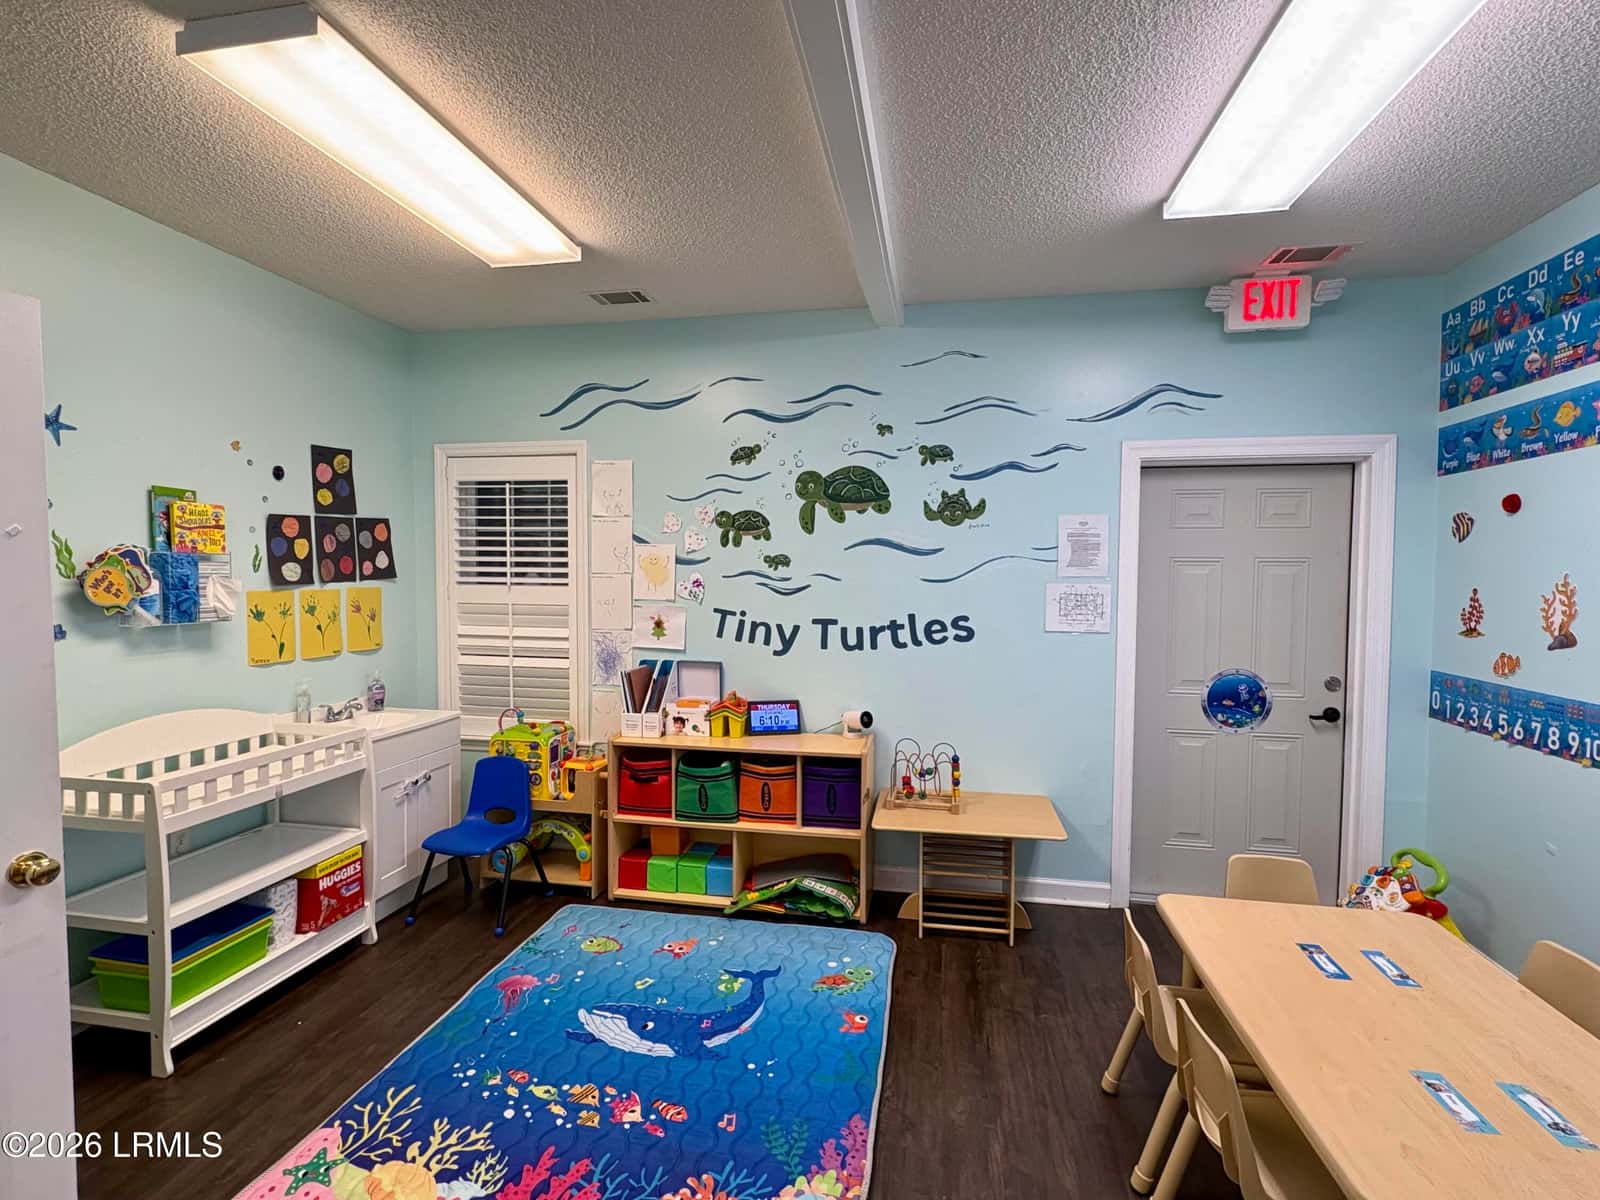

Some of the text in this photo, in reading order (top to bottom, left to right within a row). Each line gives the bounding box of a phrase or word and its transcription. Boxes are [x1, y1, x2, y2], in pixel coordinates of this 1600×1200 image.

[1243, 280, 1301, 322] EXIT
[1446, 250, 1585, 328] Aa Bb Cc Dd Ee
[1445, 361, 1460, 377] Uu
[1470, 351, 1485, 368] Vv
[1494, 339, 1515, 356] Ww
[1527, 326, 1545, 346] Xx
[1562, 311, 1582, 334] Yy
[1554, 431, 1579, 444] Yellow
[713, 607, 976, 657] Tiny Turtles
[758, 703, 790, 711] THURSDAY
[759, 715, 780, 726] 6:10
[1432, 690, 1600, 761] 0 1 2 3 4 5 6 7 8 9 10
[319, 860, 361, 891] HUGGIES
